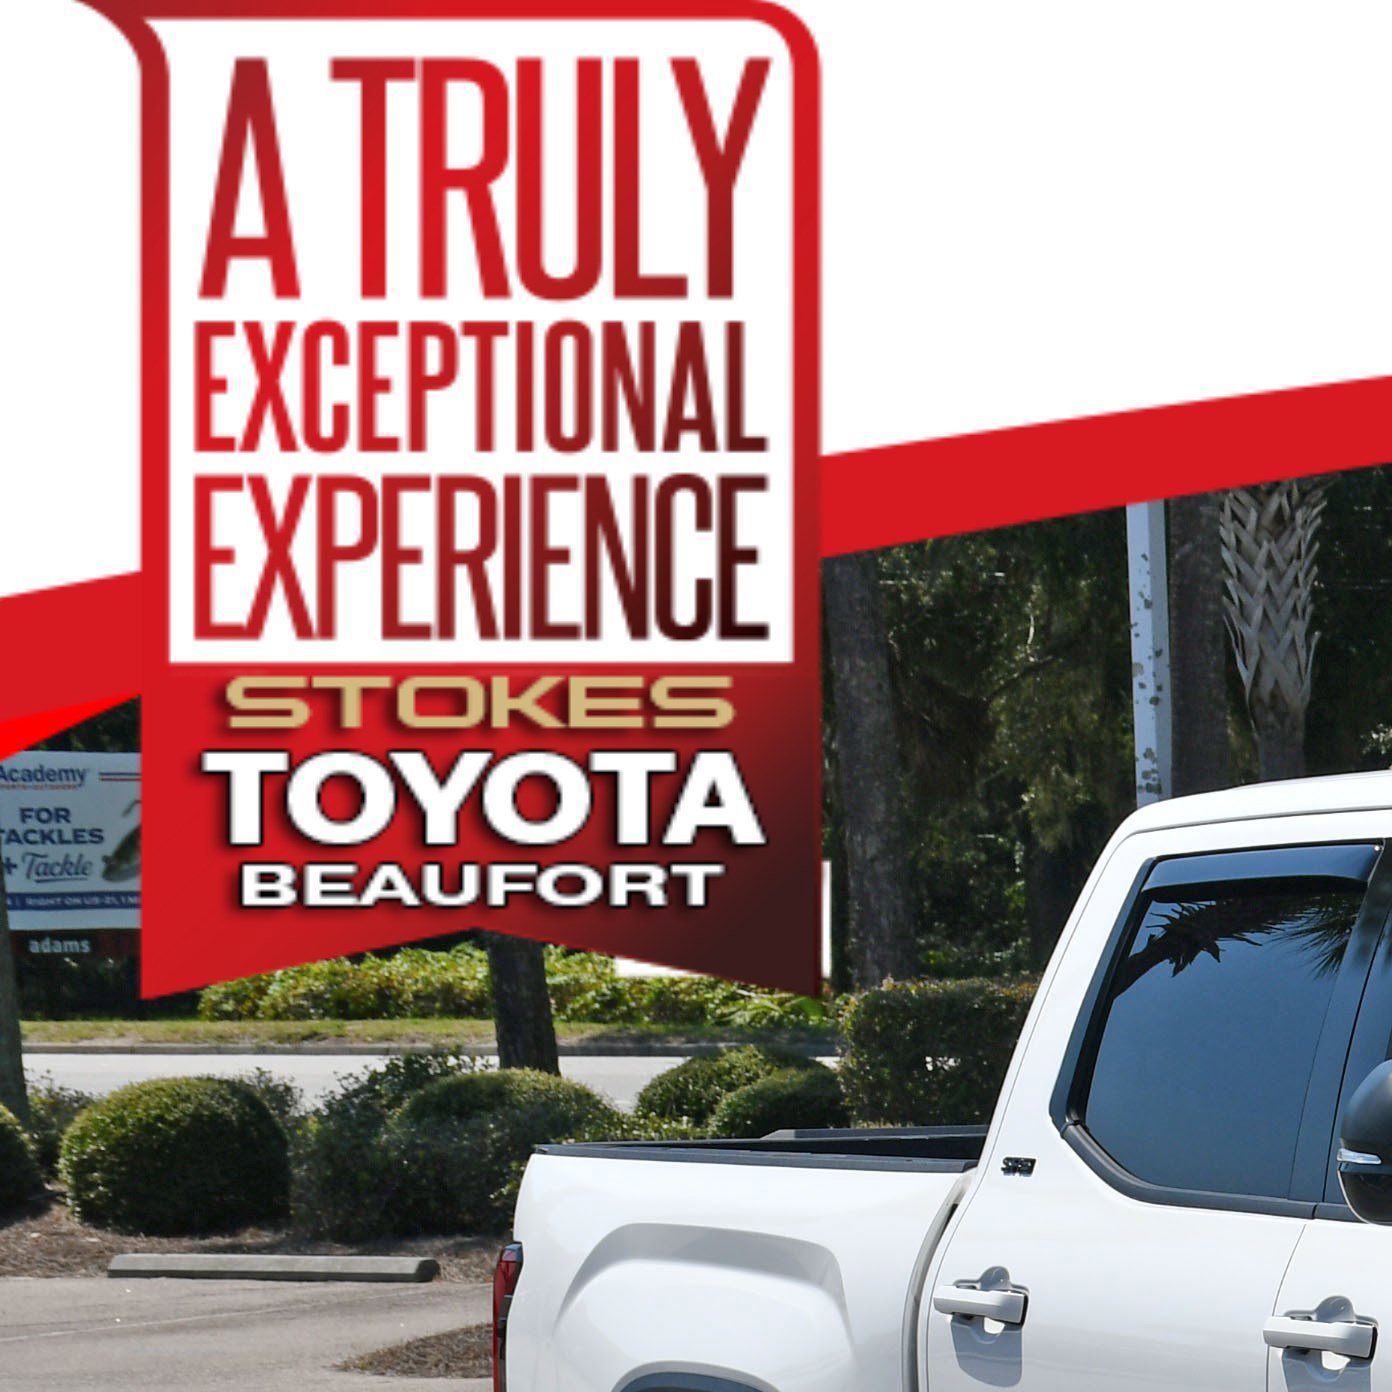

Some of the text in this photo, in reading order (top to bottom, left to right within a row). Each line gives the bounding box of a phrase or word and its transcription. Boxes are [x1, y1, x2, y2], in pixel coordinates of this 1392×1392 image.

[20, 807, 71, 823] FOR
[22, 852, 94, 882] Tackle
[29, 937, 91, 953] adams
